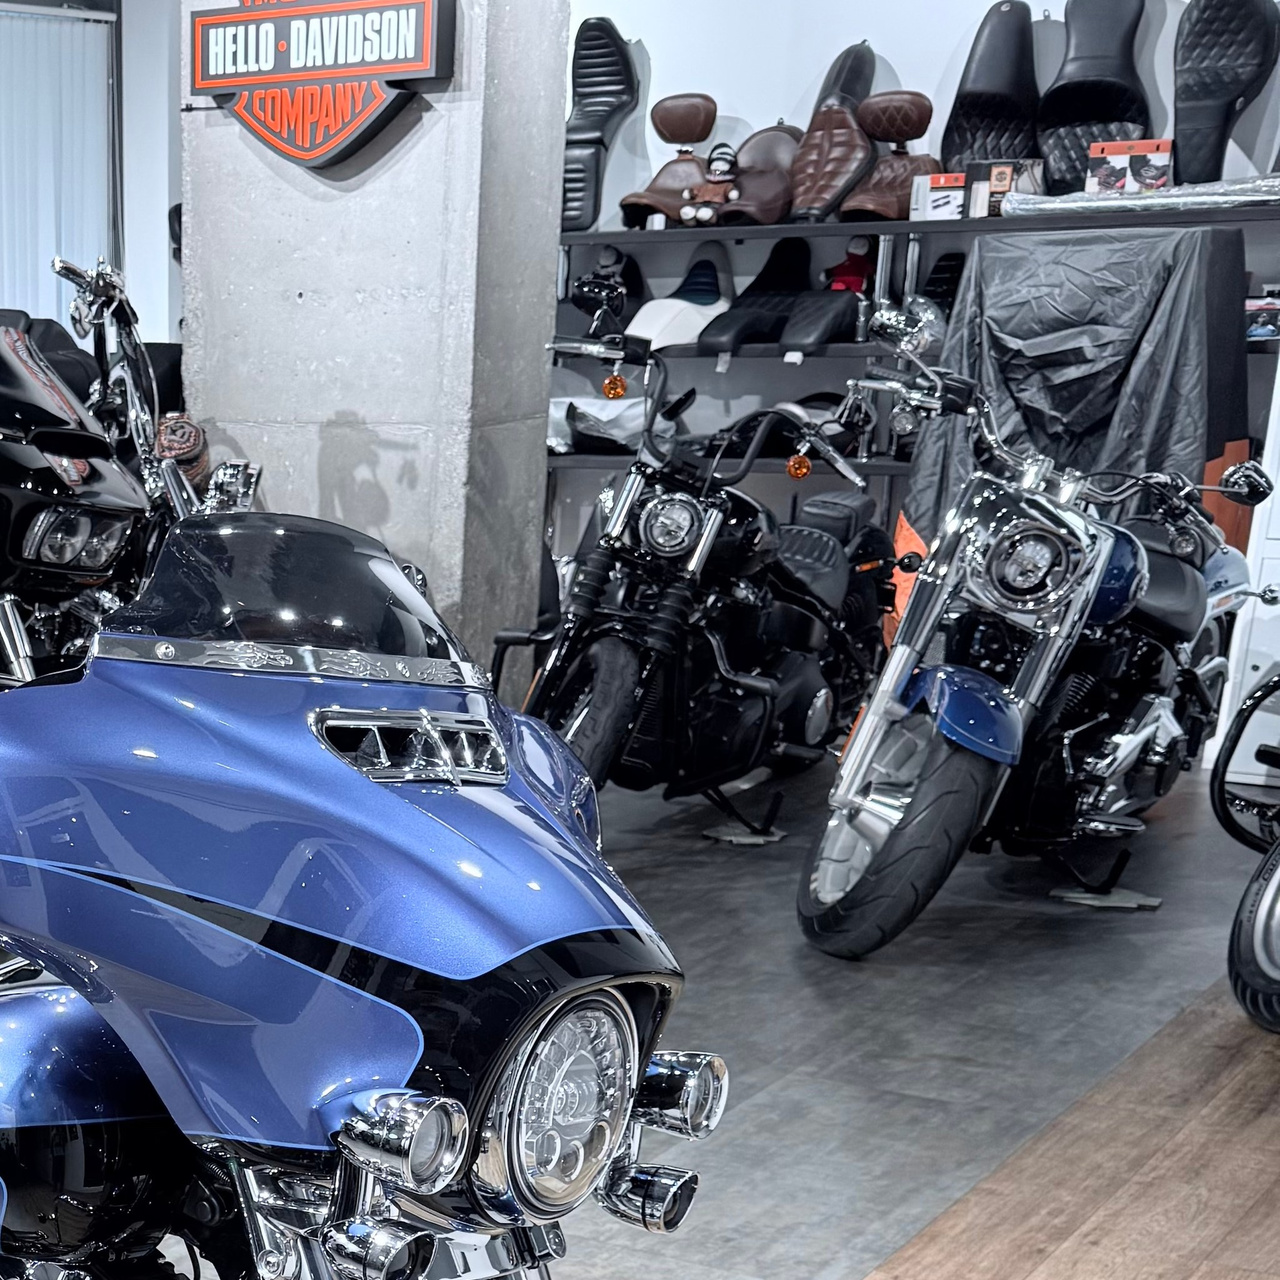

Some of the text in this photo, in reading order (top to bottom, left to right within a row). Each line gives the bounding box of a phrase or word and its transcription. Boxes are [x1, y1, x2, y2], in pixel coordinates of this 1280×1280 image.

[208, 8, 417, 75] HELLO DAVIDSON
[252, 81, 368, 148] COMPANY
